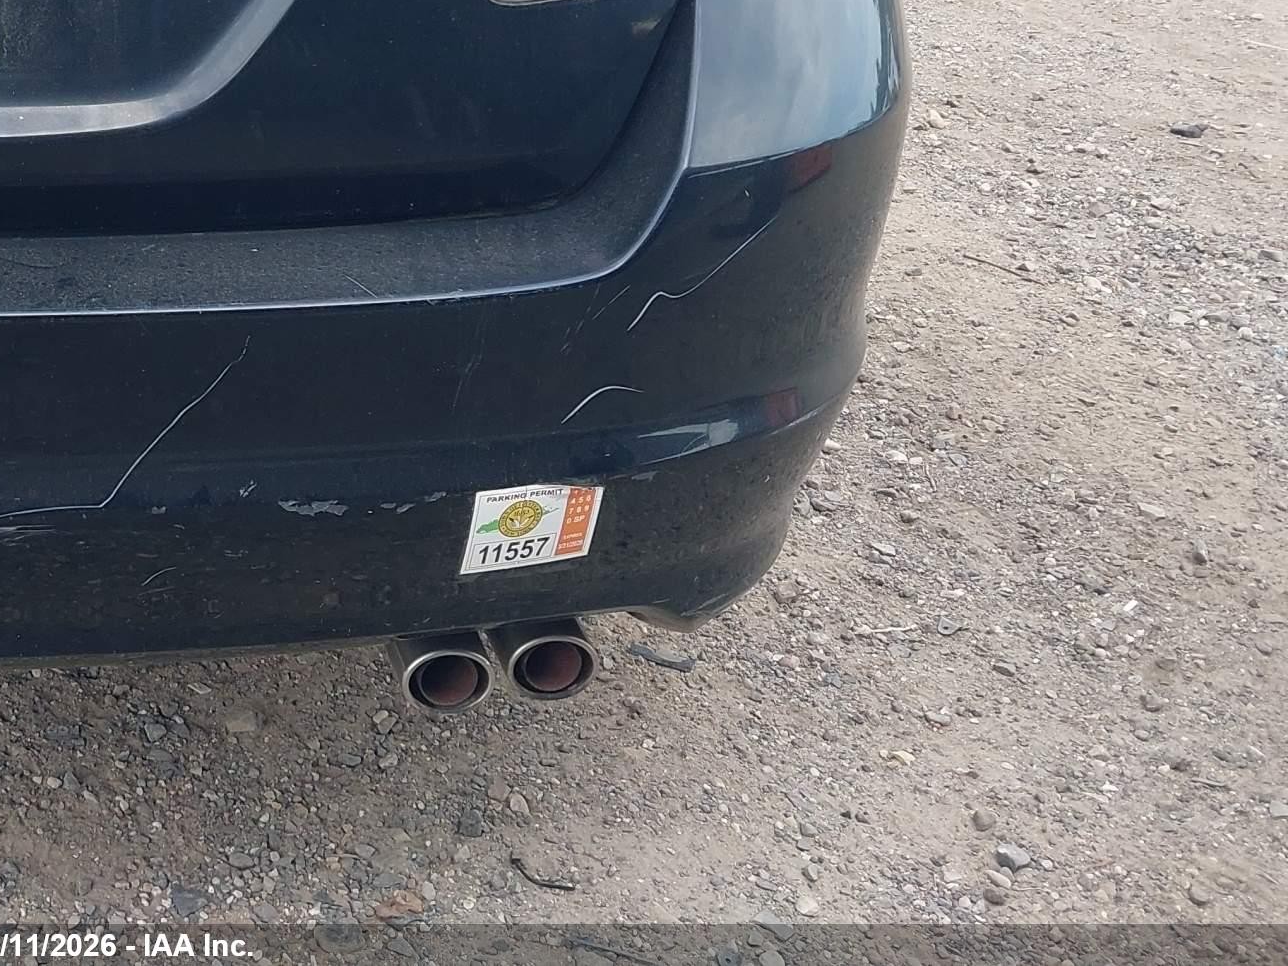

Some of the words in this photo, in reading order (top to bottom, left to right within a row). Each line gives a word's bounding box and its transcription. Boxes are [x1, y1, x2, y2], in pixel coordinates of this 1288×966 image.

[486, 492, 527, 503] PARKING
[529, 488, 564, 498] PERMIT
[479, 536, 550, 565] 11557
